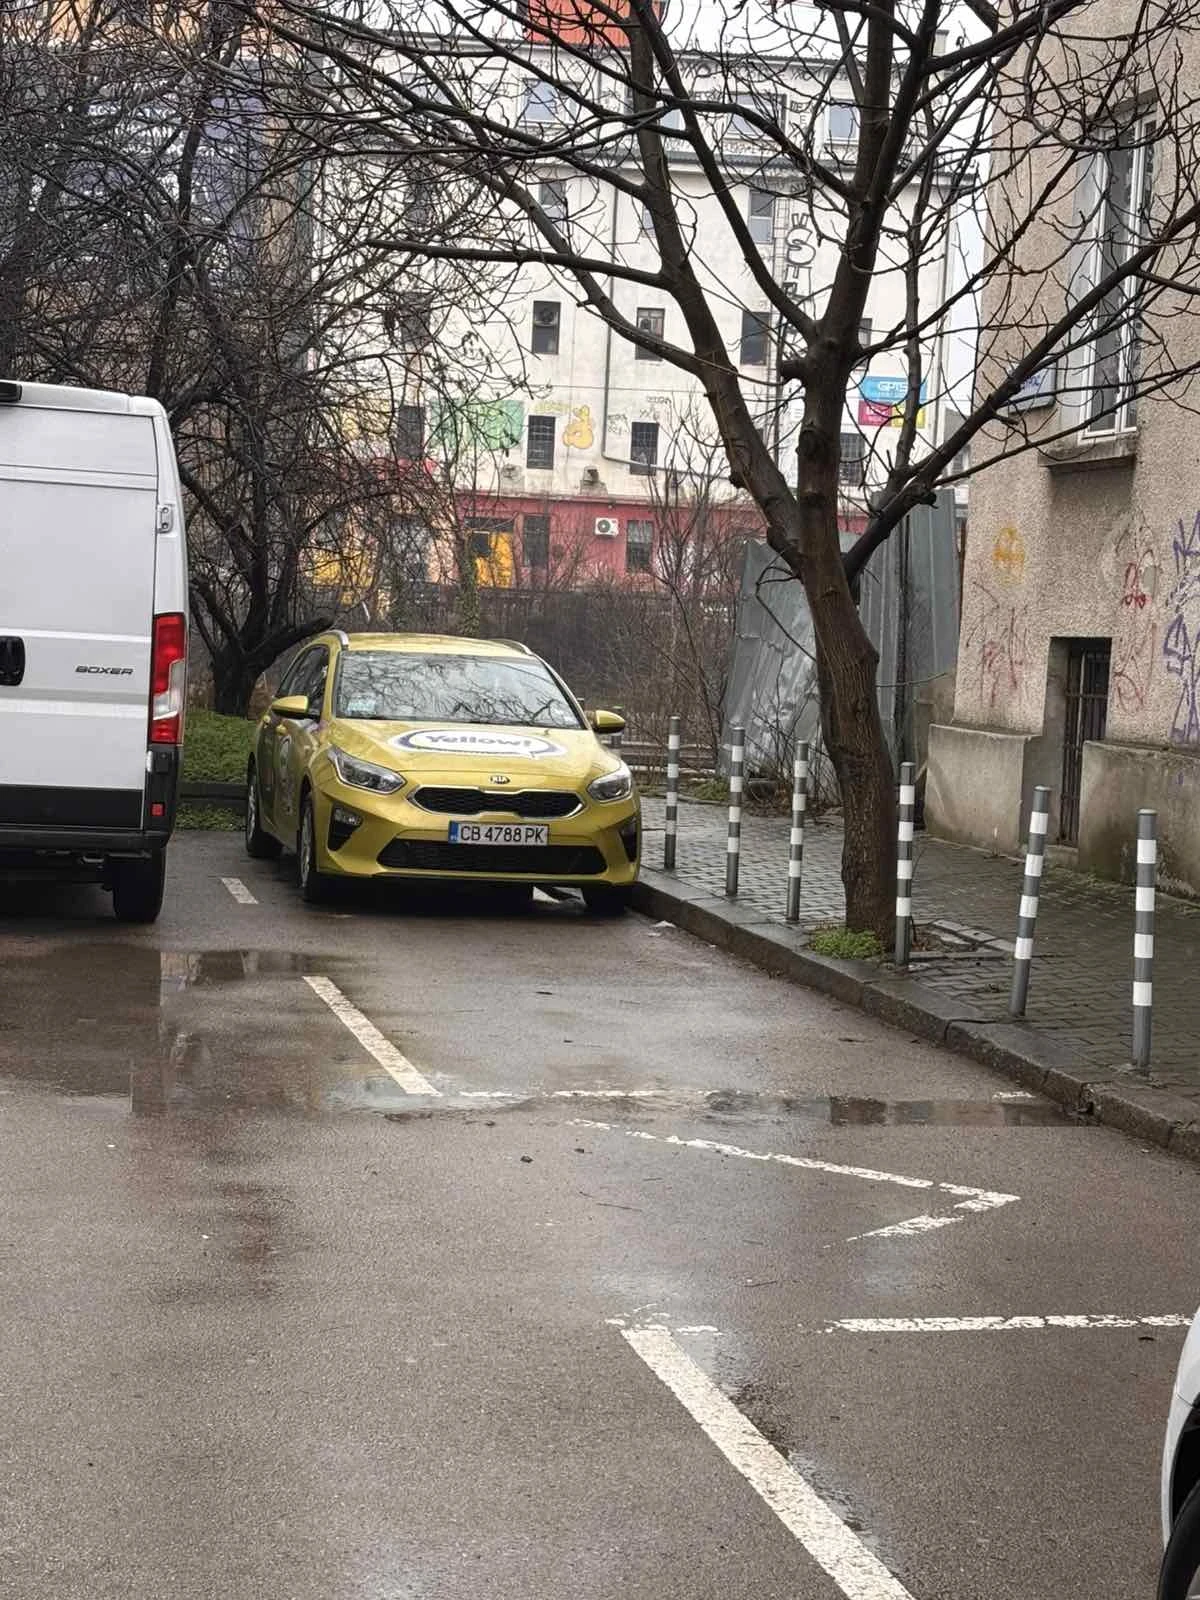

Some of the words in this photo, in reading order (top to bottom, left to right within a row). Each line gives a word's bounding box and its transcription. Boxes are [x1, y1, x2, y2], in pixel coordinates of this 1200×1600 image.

[75, 665, 134, 675] BOXER
[425, 735, 531, 746] Yellow!
[461, 825, 481, 842] CB
[484, 826, 522, 843] 4788
[524, 826, 544, 844] PK
